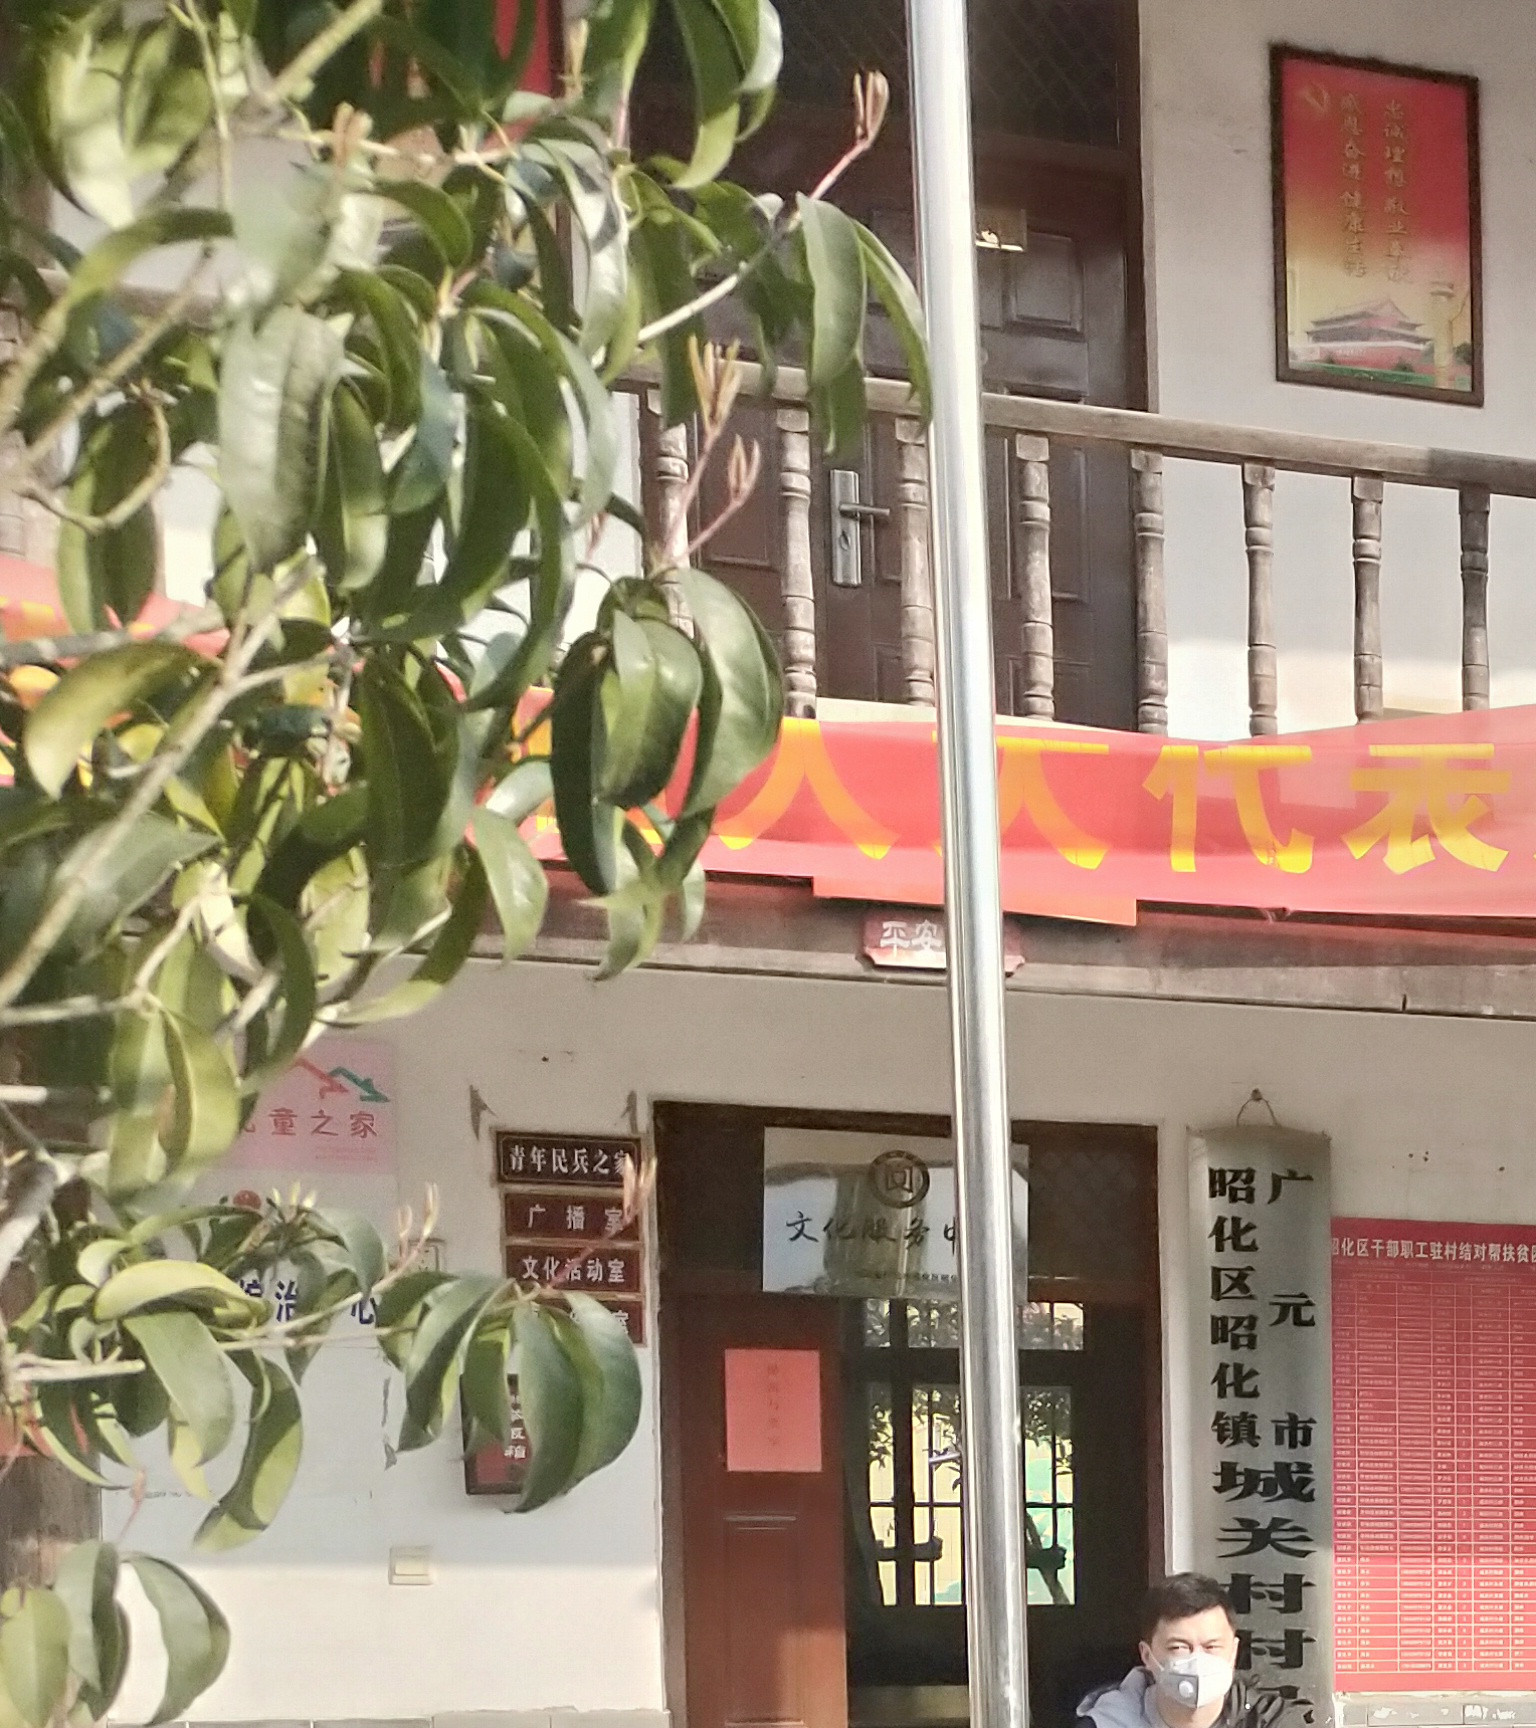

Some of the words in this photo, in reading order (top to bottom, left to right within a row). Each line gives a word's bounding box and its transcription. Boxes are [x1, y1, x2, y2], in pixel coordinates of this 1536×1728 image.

[241, 1107, 377, 1139] 童之家
[509, 1143, 631, 1176] 青年民兵之家
[527, 1203, 626, 1233] 广播室
[521, 1254, 626, 1284] 文化活动室
[1266, 1167, 1318, 1450] 广元市
